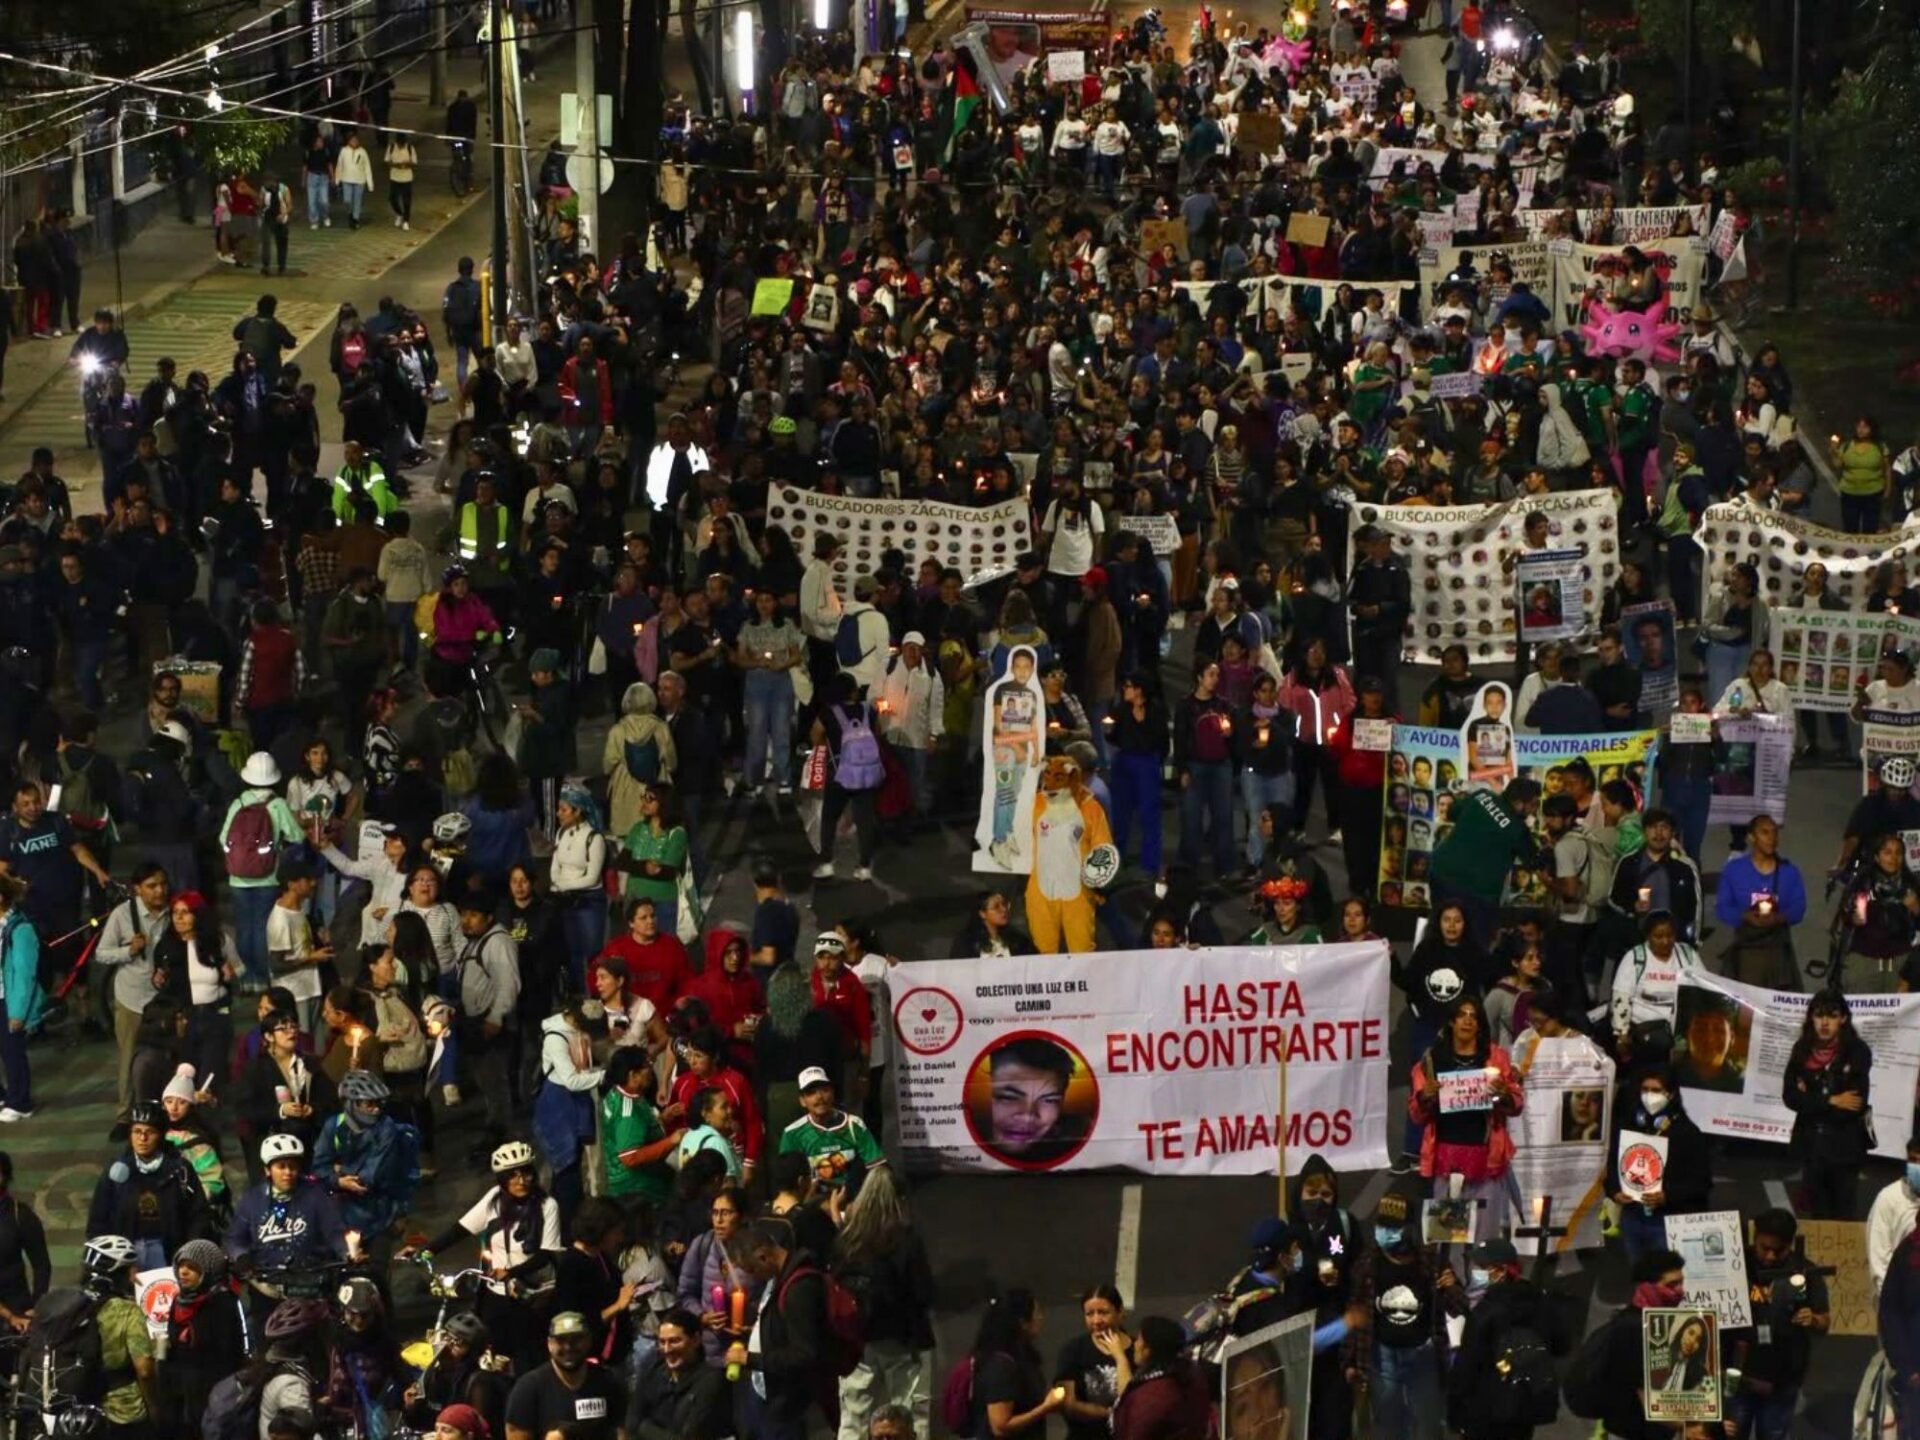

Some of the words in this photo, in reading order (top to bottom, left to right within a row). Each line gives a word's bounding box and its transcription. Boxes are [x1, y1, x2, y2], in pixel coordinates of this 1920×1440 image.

[805, 495, 905, 516] BUSCADOR@S
[910, 501, 990, 523] ZACATECAS
[1384, 508, 1489, 524] BUSCADOR@S
[1705, 508, 1807, 534] BUSCADOR@S
[975, 985, 1023, 998] COLECTIVO
[1025, 983, 1044, 995] UNA
[1046, 982, 1062, 994] LUZ
[1064, 981, 1076, 992] EN
[1078, 980, 1088, 992] EL
[1015, 1000, 1051, 1012] CAMINO
[1183, 980, 1305, 1025] HASTA
[1106, 1019, 1381, 1074] ENCONTRARTE
[924, 1061, 956, 1070] Daniel
[899, 1076, 945, 1085] González
[1138, 1121, 1185, 1161] TE
[1194, 1109, 1353, 1157] AMAMOS
